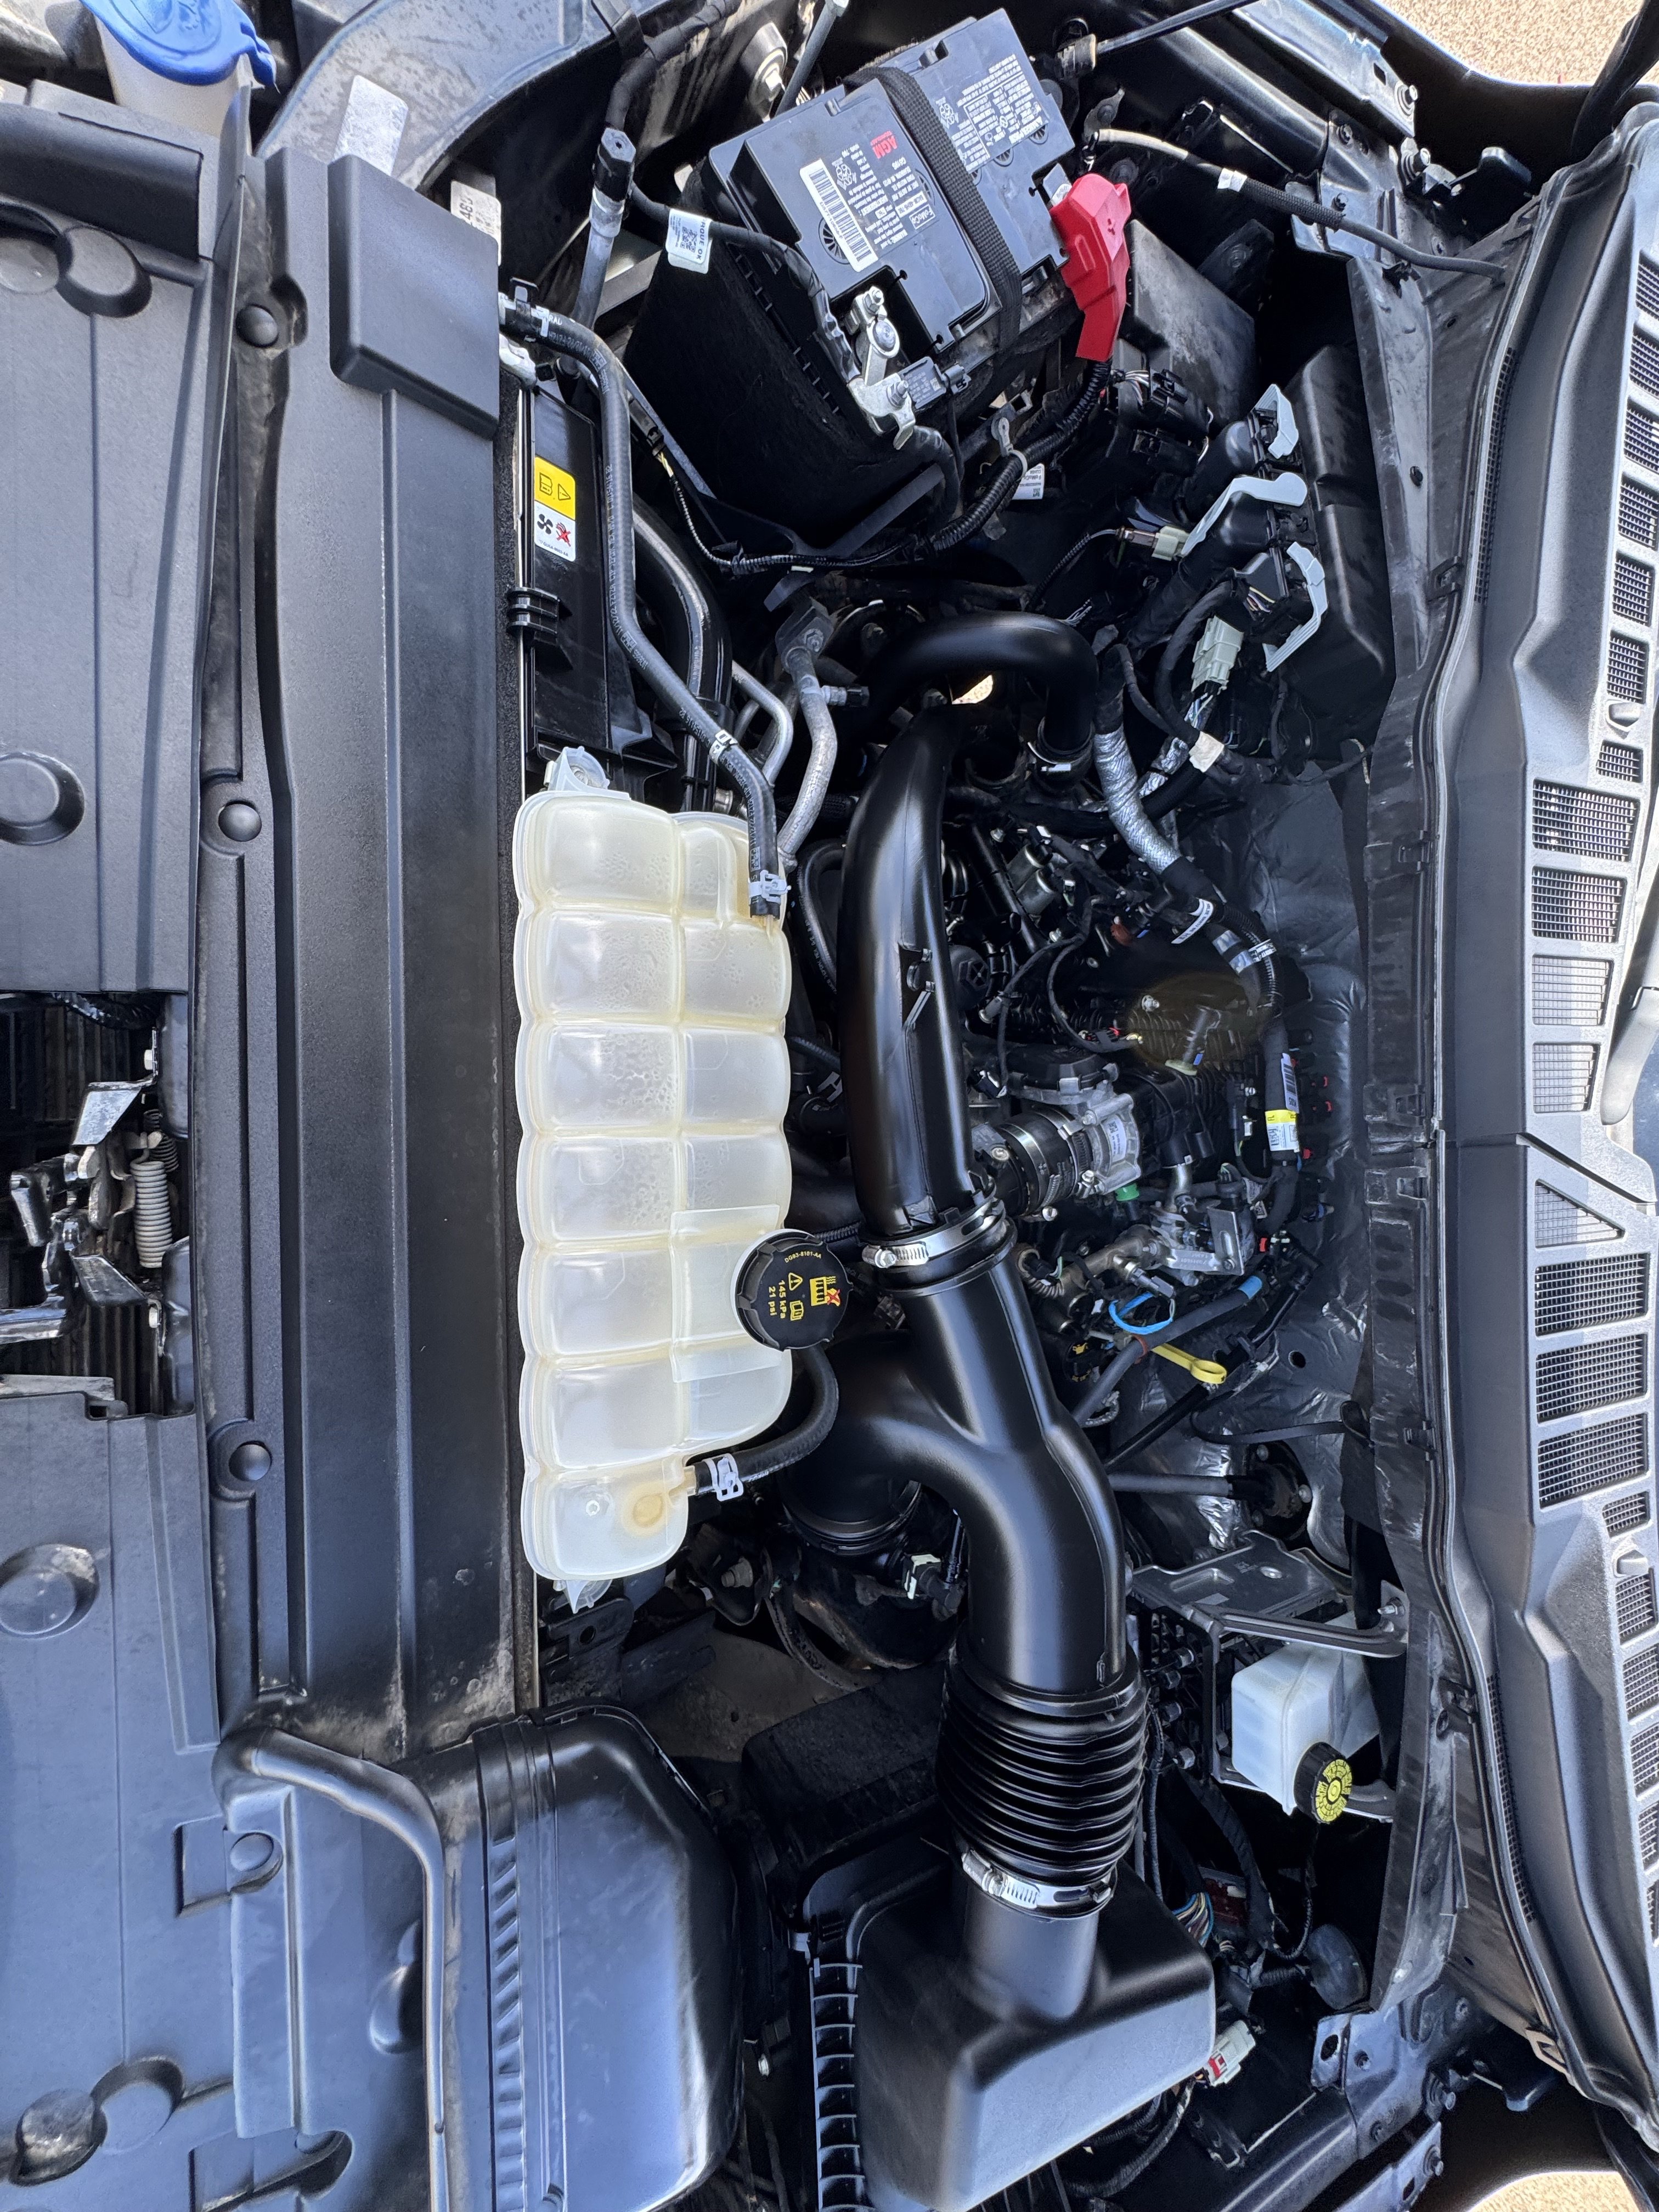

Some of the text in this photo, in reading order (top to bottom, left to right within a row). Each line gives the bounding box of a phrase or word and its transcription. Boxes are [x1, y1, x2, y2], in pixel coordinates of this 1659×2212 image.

[871, 135, 899, 159] AGM
[911, 207, 933, 225] FoMoCo
[696, 250, 703, 260] OK
[785, 1251, 822, 1263] DG93-8101-AA
[768, 1286, 777, 1316] 21 psi
[779, 1300, 787, 1318] kPa
